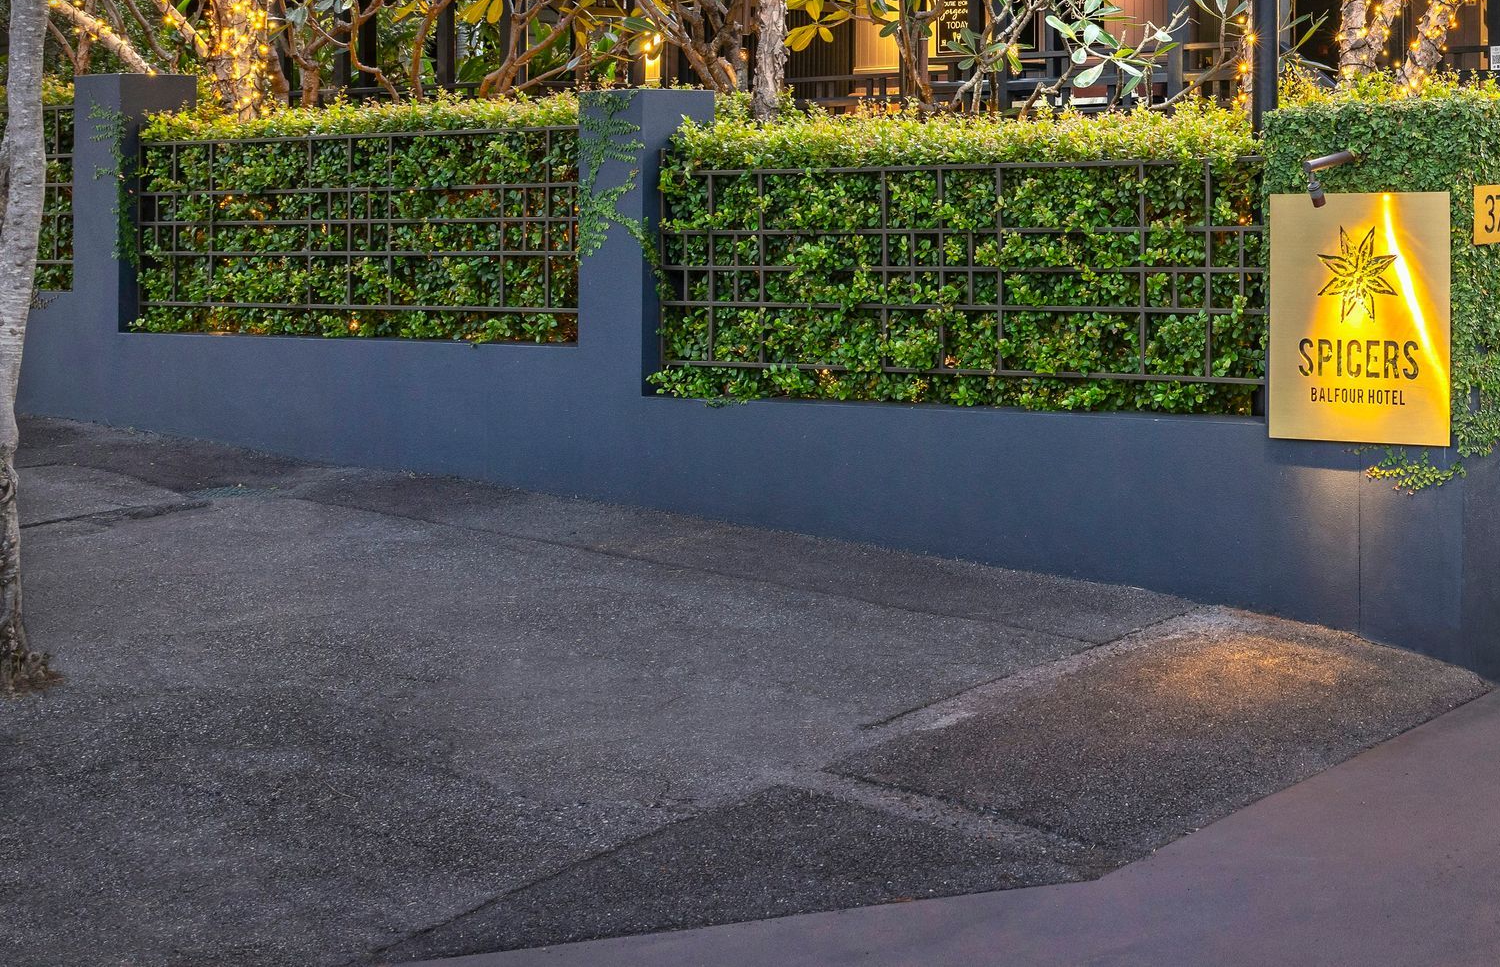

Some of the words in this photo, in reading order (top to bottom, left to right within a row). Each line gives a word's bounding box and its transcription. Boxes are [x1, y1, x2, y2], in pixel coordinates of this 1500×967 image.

[1298, 337, 1420, 380] SPICERS
[1310, 387, 1364, 405] BALFOUR
[1368, 390, 1406, 406] HOTEL
